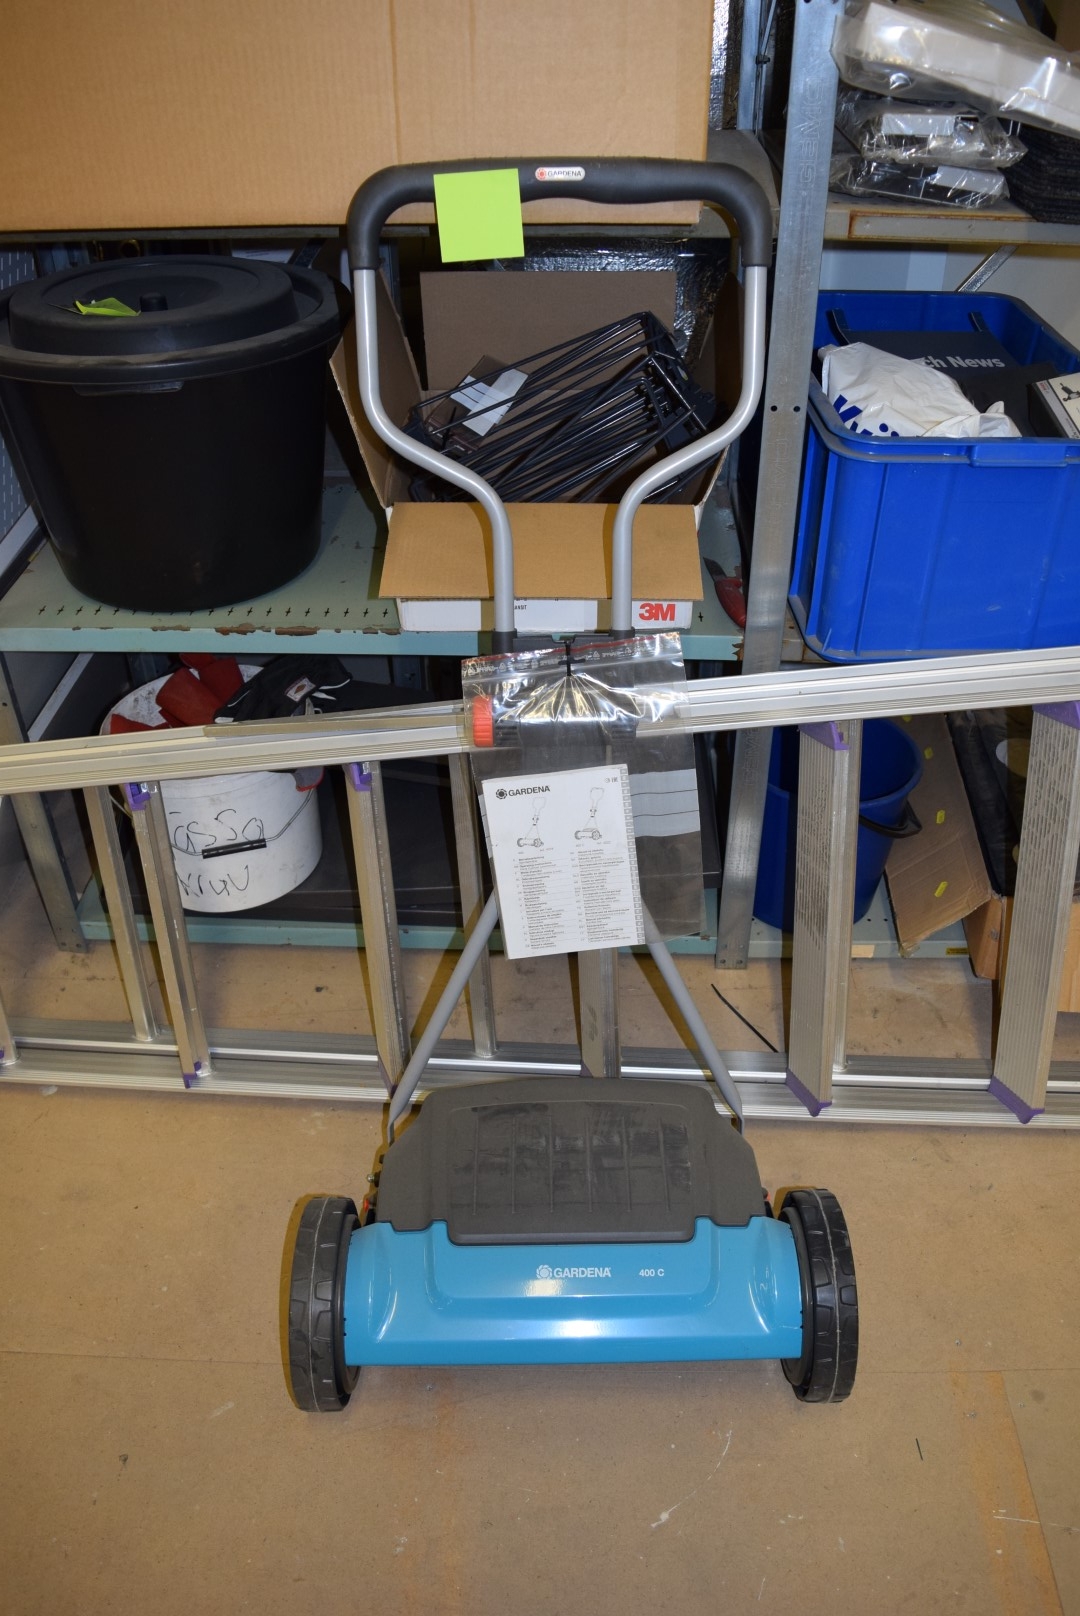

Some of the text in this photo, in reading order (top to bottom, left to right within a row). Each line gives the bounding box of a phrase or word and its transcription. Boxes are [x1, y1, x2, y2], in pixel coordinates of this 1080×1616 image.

[945, 355, 1006, 368] News
[638, 602, 676, 622] 3M
[508, 785, 551, 797] GARDENA
[553, 1267, 665, 1278] GARDENA 400 C
